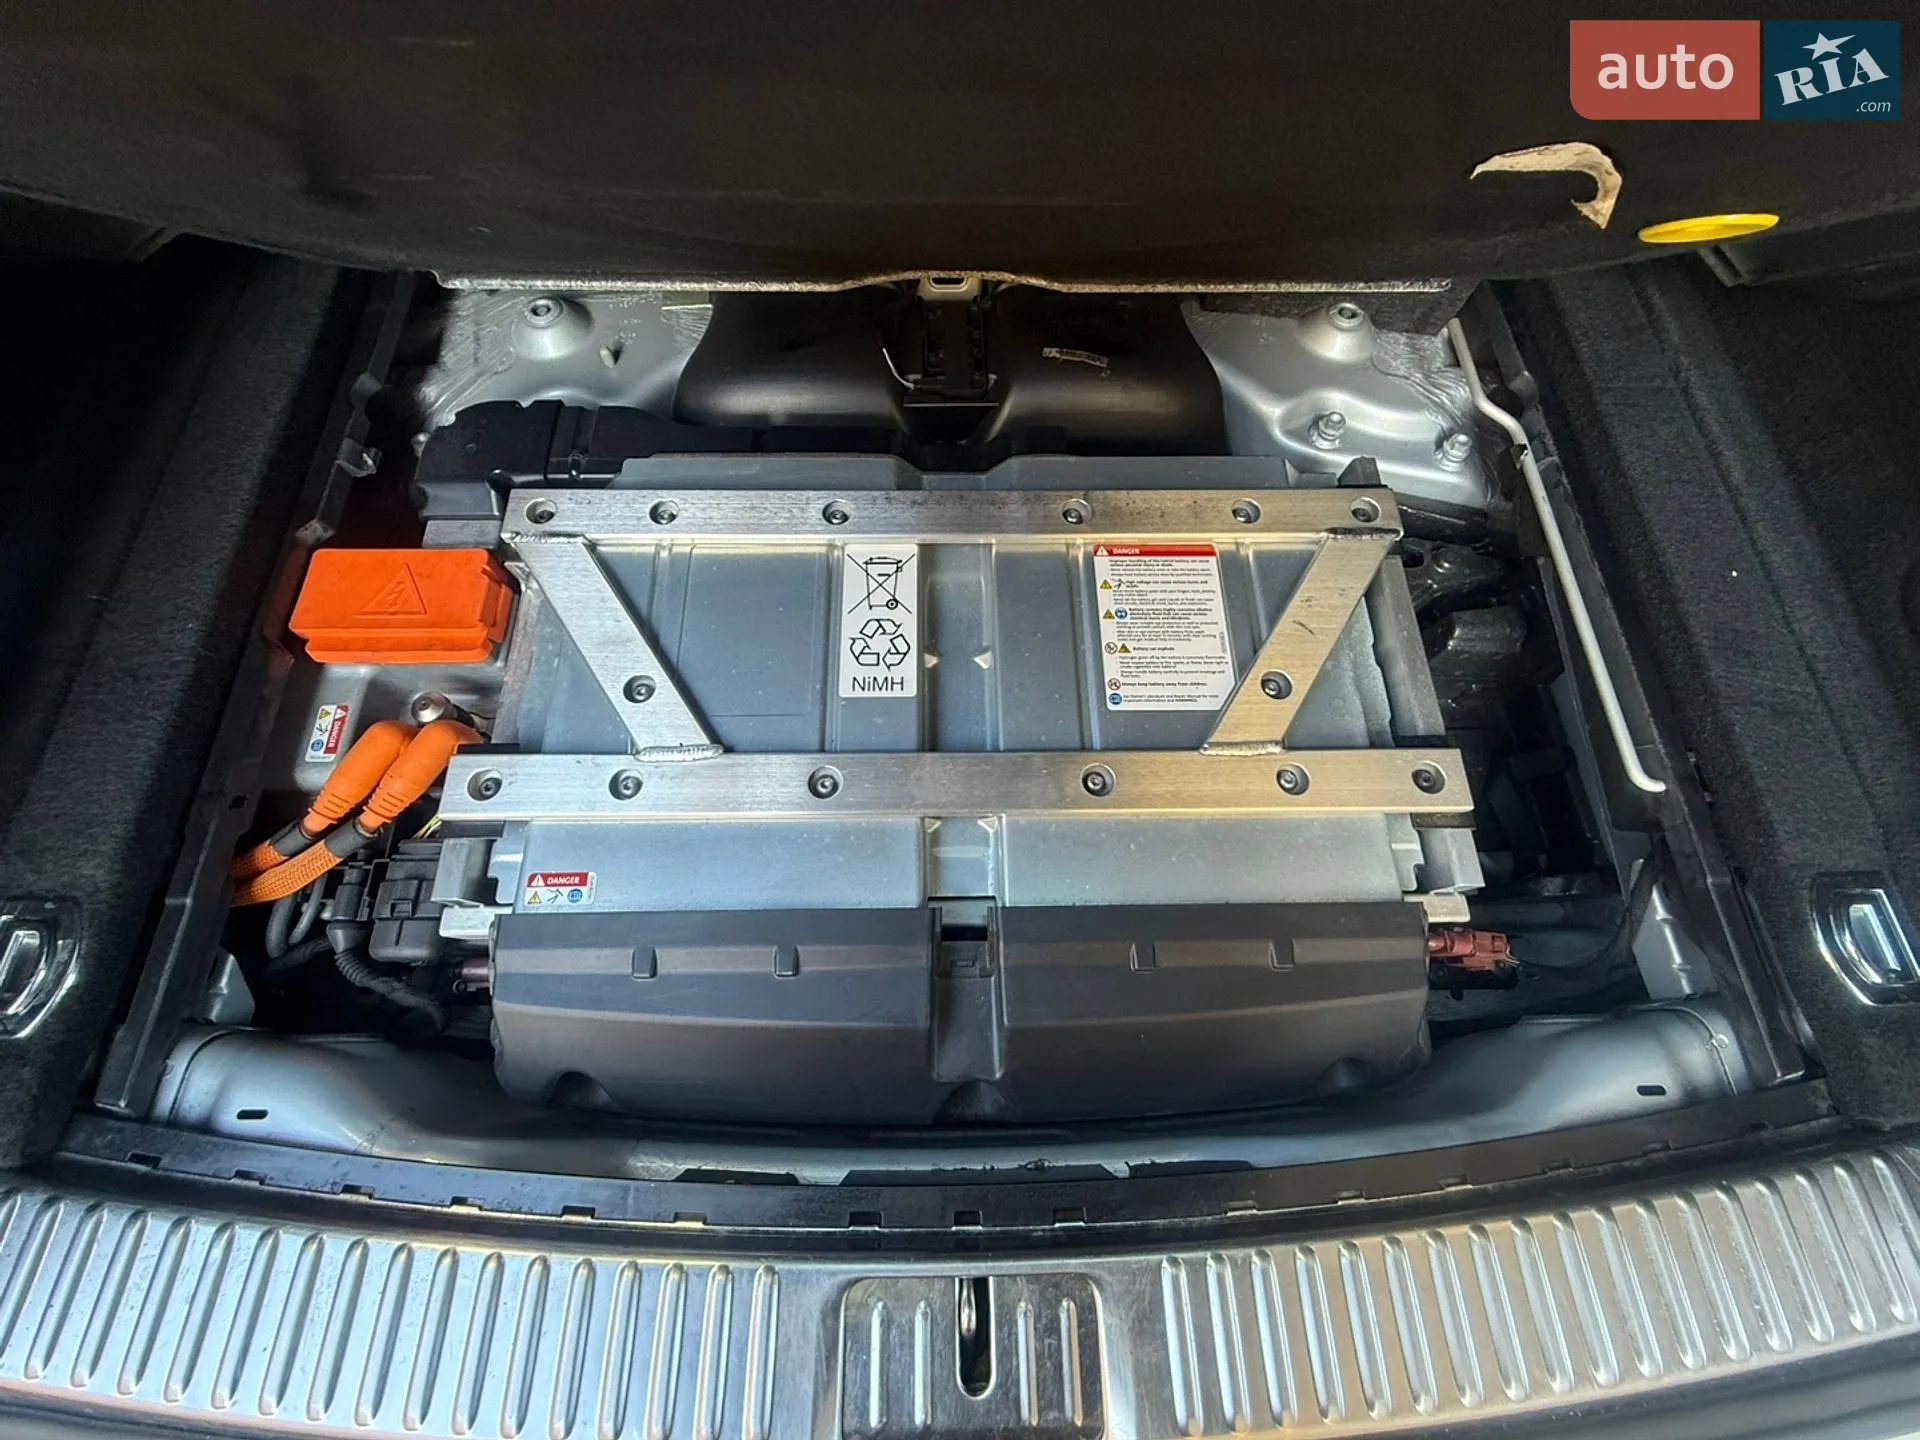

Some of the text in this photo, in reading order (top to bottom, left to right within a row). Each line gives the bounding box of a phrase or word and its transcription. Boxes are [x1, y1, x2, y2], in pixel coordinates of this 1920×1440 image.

[1112, 547, 1140, 555] DANGER
[852, 676, 904, 692] NiMH
[326, 721, 342, 748] DANGER
[546, 876, 580, 885] DANGER
